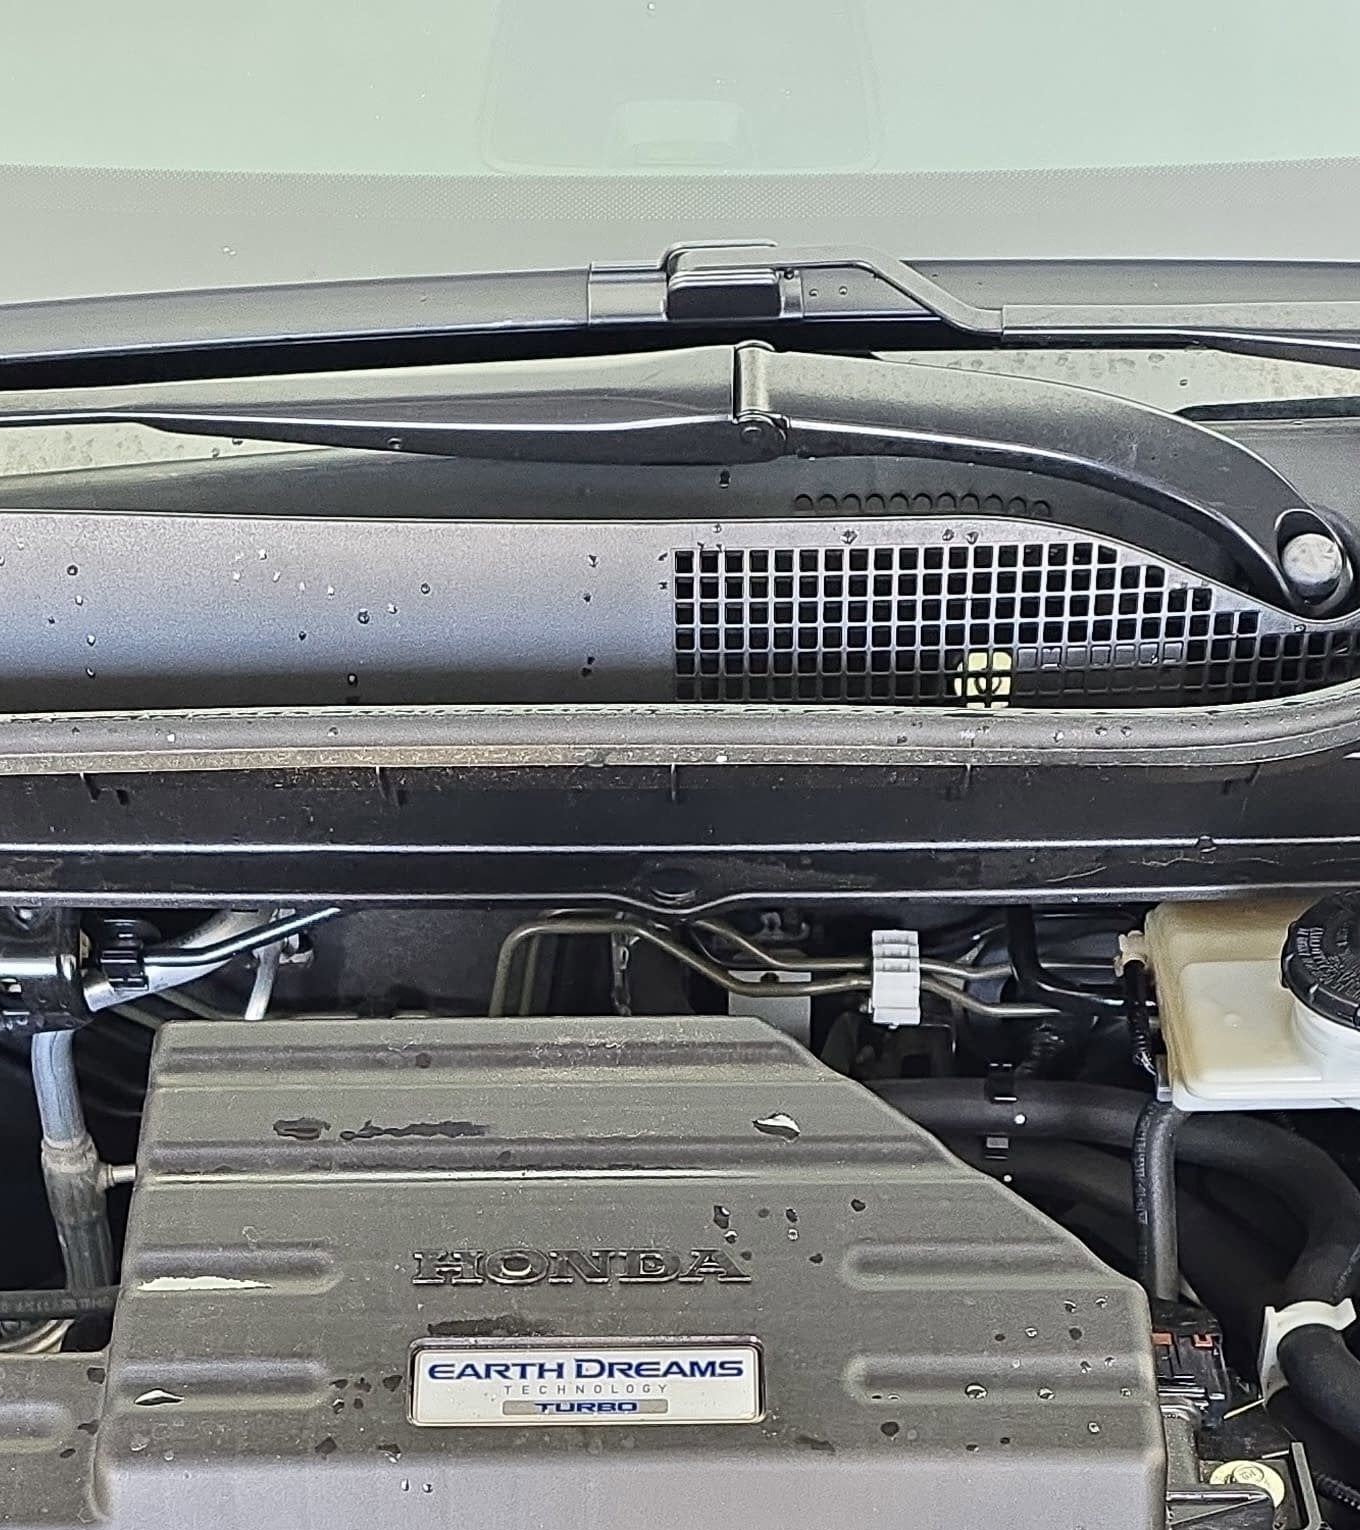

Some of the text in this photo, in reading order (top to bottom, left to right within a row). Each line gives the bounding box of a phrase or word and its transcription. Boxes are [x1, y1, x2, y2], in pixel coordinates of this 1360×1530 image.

[412, 1248, 753, 1285] HONDA
[427, 1357, 744, 1380] EARTH DREAMS
[504, 1384, 669, 1395] TECHNOLOGY
[534, 1402, 638, 1413] TURBO
